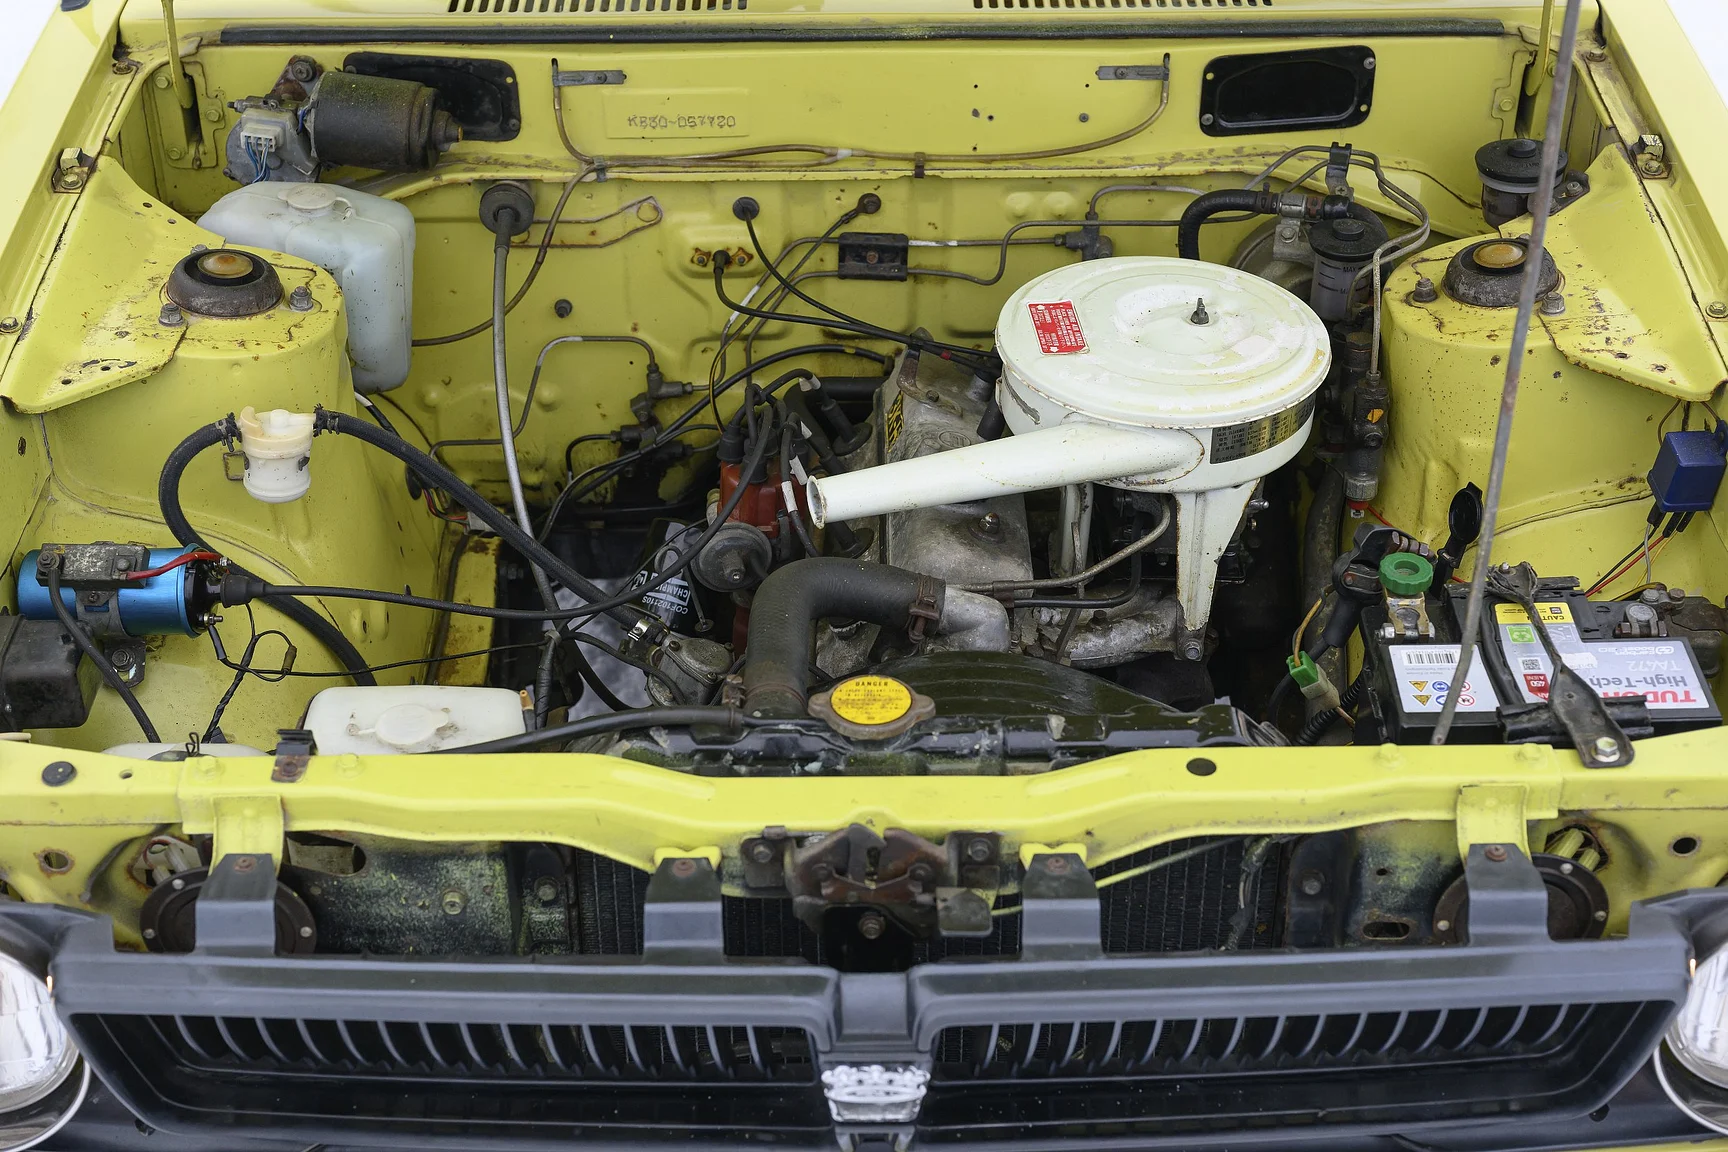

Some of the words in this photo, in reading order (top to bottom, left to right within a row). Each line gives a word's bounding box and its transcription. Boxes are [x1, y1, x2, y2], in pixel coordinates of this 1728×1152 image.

[642, 596, 688, 614] COF102110S
[1626, 660, 1682, 671] TA472
[1589, 674, 1688, 688] High-Tech
